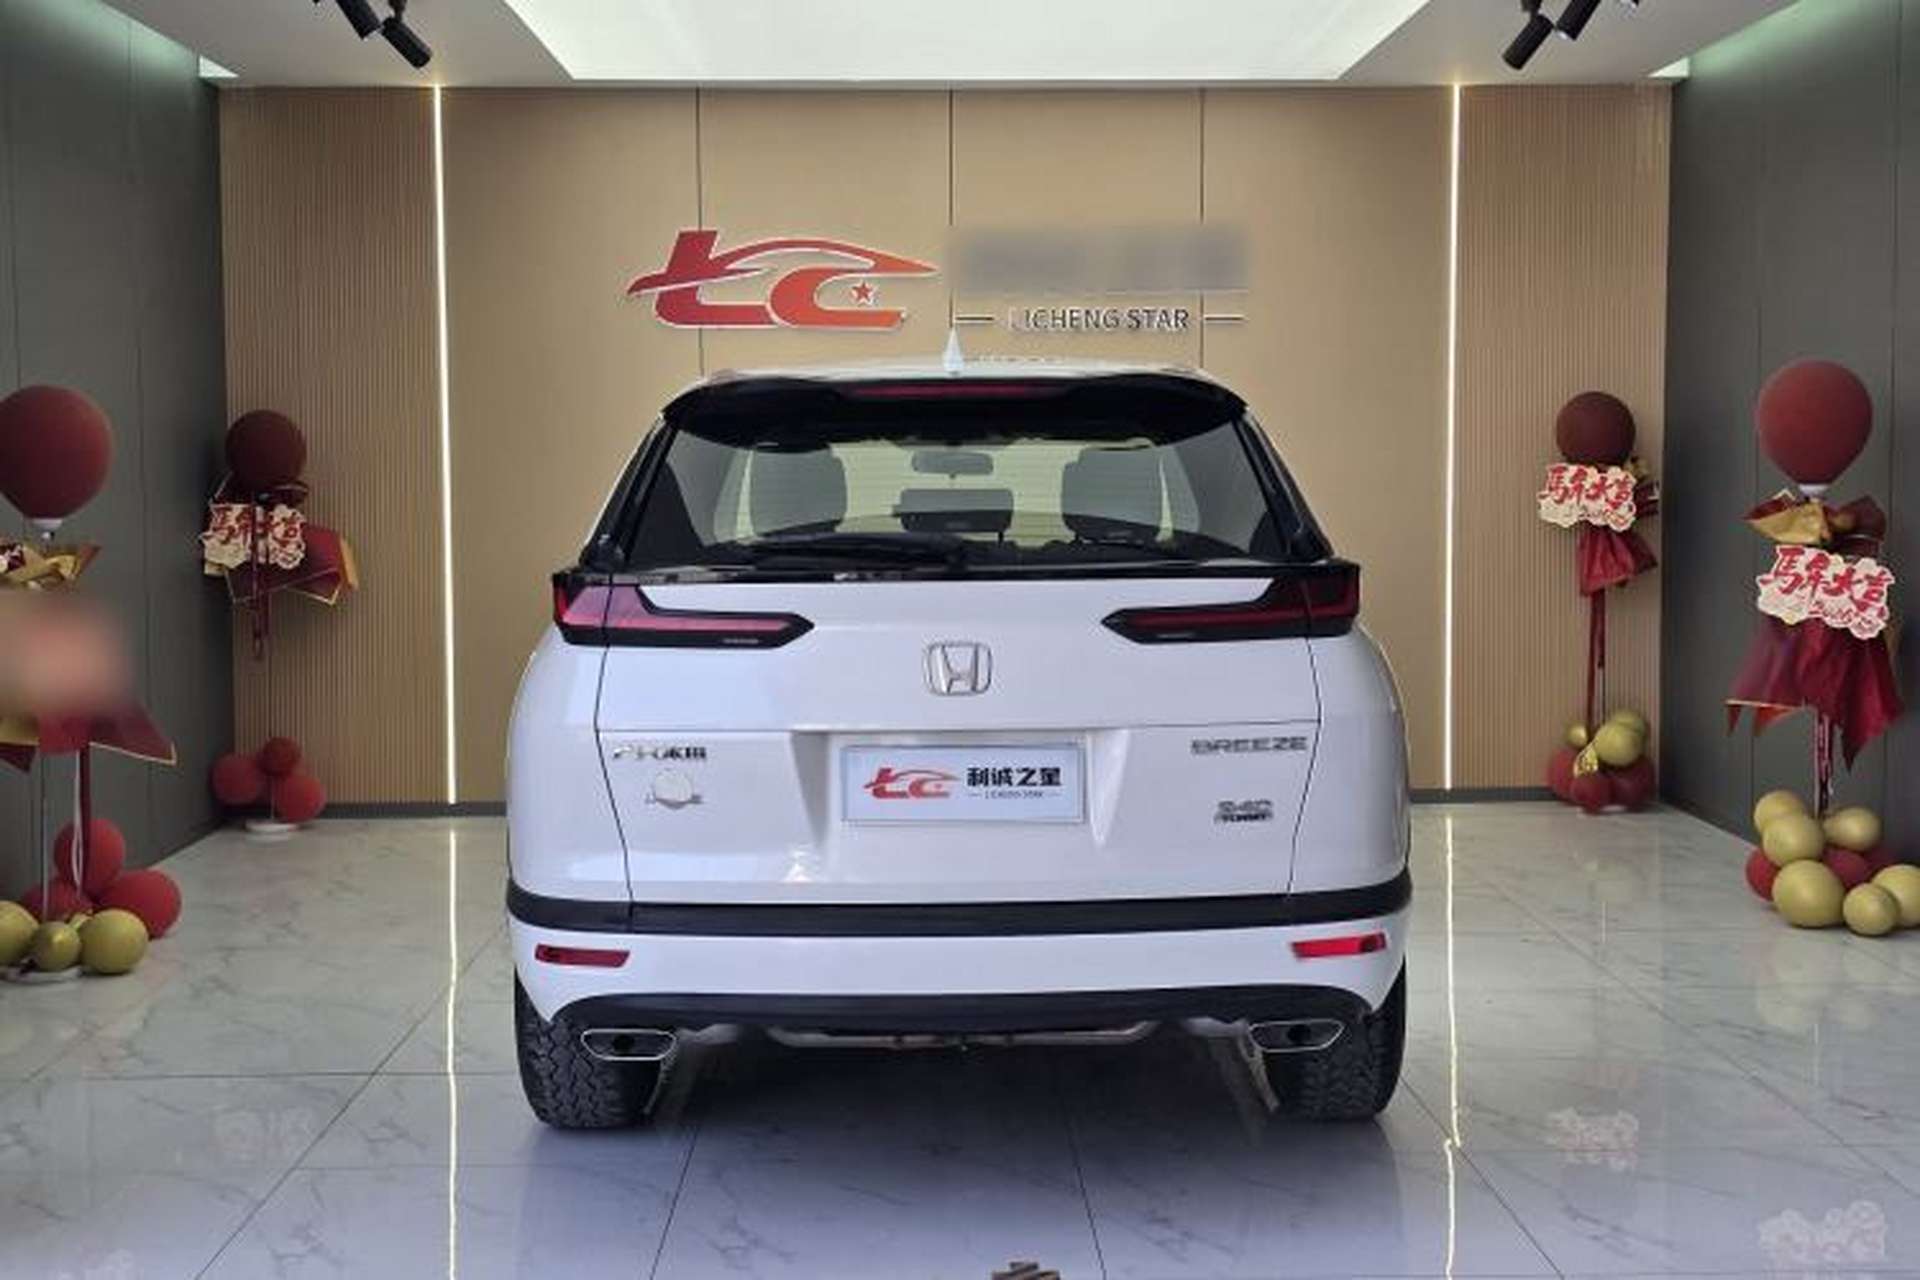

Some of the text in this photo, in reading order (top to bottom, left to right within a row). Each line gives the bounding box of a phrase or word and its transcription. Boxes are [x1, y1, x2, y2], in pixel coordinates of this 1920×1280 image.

[1127, 308, 1190, 330] STAR
[1191, 736, 1308, 754] BREEZE
[967, 766, 1062, 787] 利诚之星
